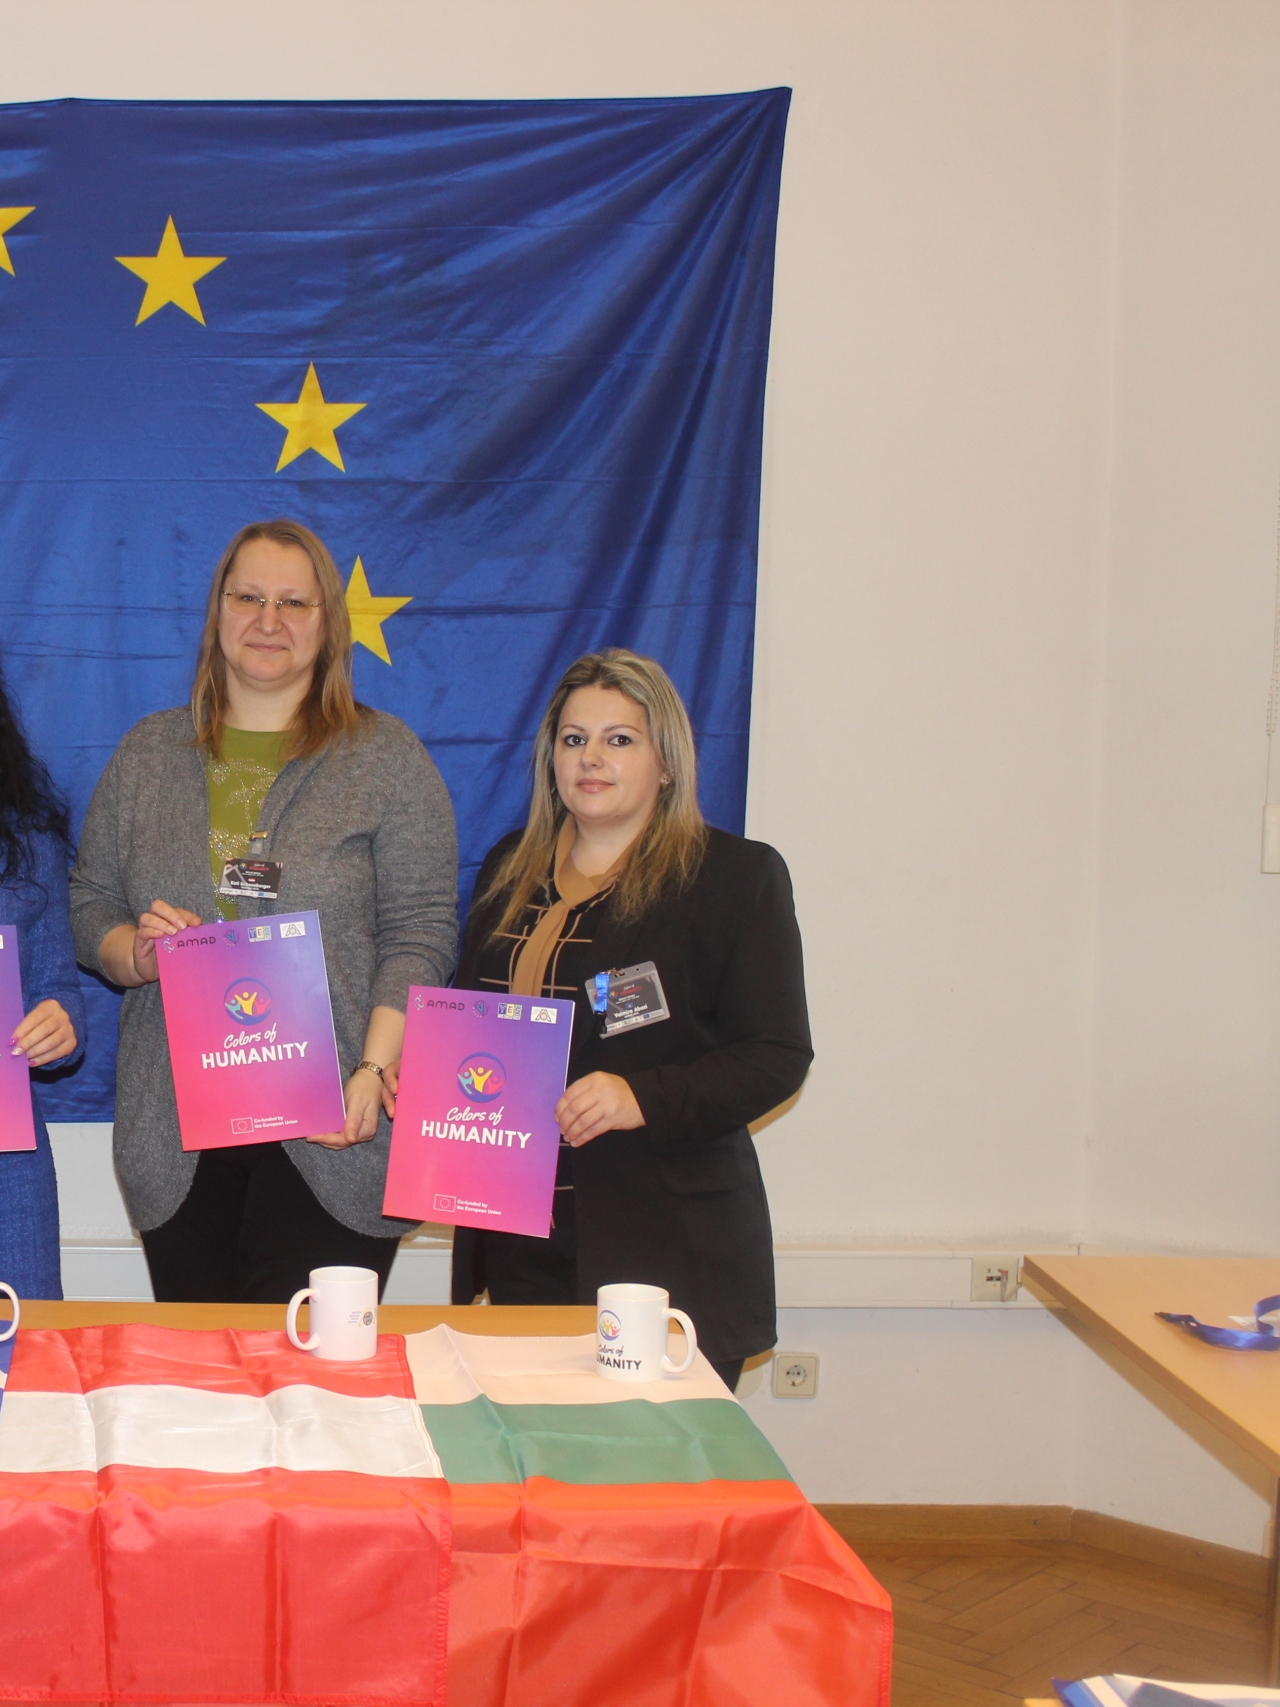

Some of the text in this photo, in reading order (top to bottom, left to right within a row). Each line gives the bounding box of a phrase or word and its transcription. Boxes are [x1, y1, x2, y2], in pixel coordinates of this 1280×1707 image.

[177, 936, 217, 948] AMAD
[427, 1000, 465, 1011] AMAD
[223, 1023, 278, 1049] Colors of
[201, 1041, 308, 1069] HUMANITY
[446, 1106, 505, 1126] Colors of
[421, 1120, 532, 1149] HUMANITY
[615, 1345, 624, 1357] of
